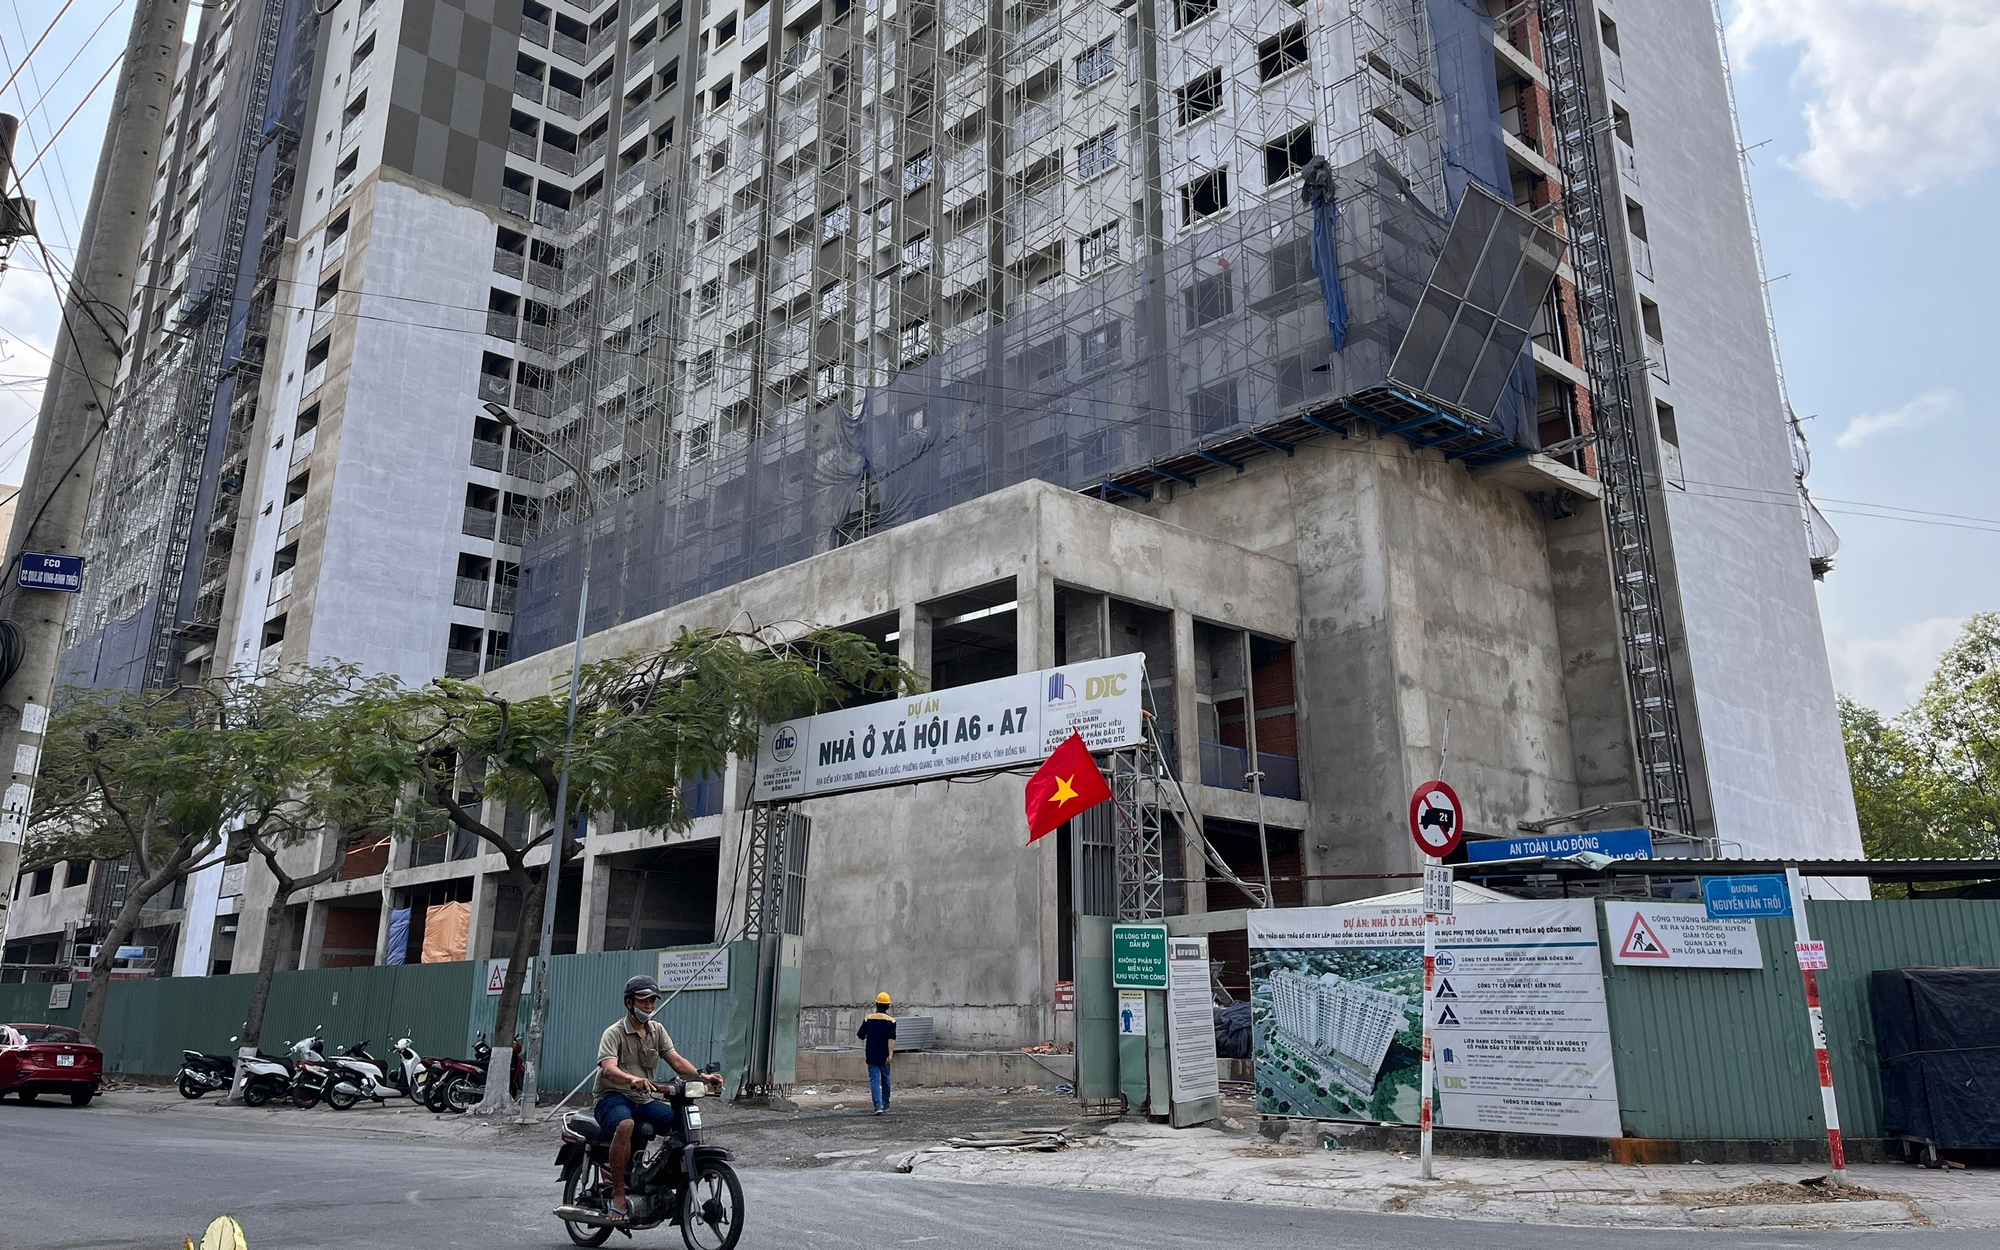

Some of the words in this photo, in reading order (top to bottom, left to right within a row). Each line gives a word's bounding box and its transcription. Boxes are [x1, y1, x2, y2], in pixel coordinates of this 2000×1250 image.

[43, 558, 60, 568] FCO
[1085, 673, 1127, 700] DTC
[908, 700, 922, 718] DỰ
[924, 697, 940, 714] ÁN
[1069, 716, 1082, 726] LIÊN
[1083, 716, 1098, 724] DANH
[1048, 728, 1064, 736] CÔNG
[1076, 724, 1089, 732] NHH
[1091, 720, 1107, 730] PHÚC
[775, 730, 794, 750] dhc
[819, 730, 856, 766] NHÀ
[862, 724, 876, 758] Ở
[880, 720, 906, 756] XÃ
[914, 716, 948, 754] HỘI
[954, 715, 981, 743] A6
[1000, 706, 1028, 736] A7
[1096, 736, 1112, 746] DỰNG
[1439, 812, 1448, 822] 2t
[1510, 843, 1522, 855] AN
[1524, 838, 1548, 854] TOÀN
[1550, 840, 1569, 852] LAO
[1571, 836, 1598, 850] ĐỘNG
[1731, 884, 1758, 894] ĐƯỜNG
[1712, 896, 1745, 910] NGUYỄN
[1745, 896, 1761, 910] VĂN
[1764, 894, 1781, 908] TRỖI
[1344, 917, 1354, 930] DỰ
[1356, 917, 1369, 928] ÁN:
[1371, 916, 1388, 927] NHÀ
[1398, 915, 1410, 927] XÃ
[1446, 916, 1456, 926] A7
[1672, 915, 1700, 923] TRƯỜNG
[1125, 932, 1139, 940] LÒNG
[1140, 931, 1150, 940] TẮT
[1152, 932, 1163, 940] MÁY
[1130, 940, 1141, 948] DẪN
[1142, 940, 1150, 948] BỘ
[1796, 942, 1809, 952] BÁN
[1810, 942, 1824, 951] NHÀ
[1684, 946, 1696, 954] LỖI
[1706, 947, 1721, 955] LÀM
[1436, 954, 1452, 966] dhc
[1444, 1076, 1467, 1090] DTC
